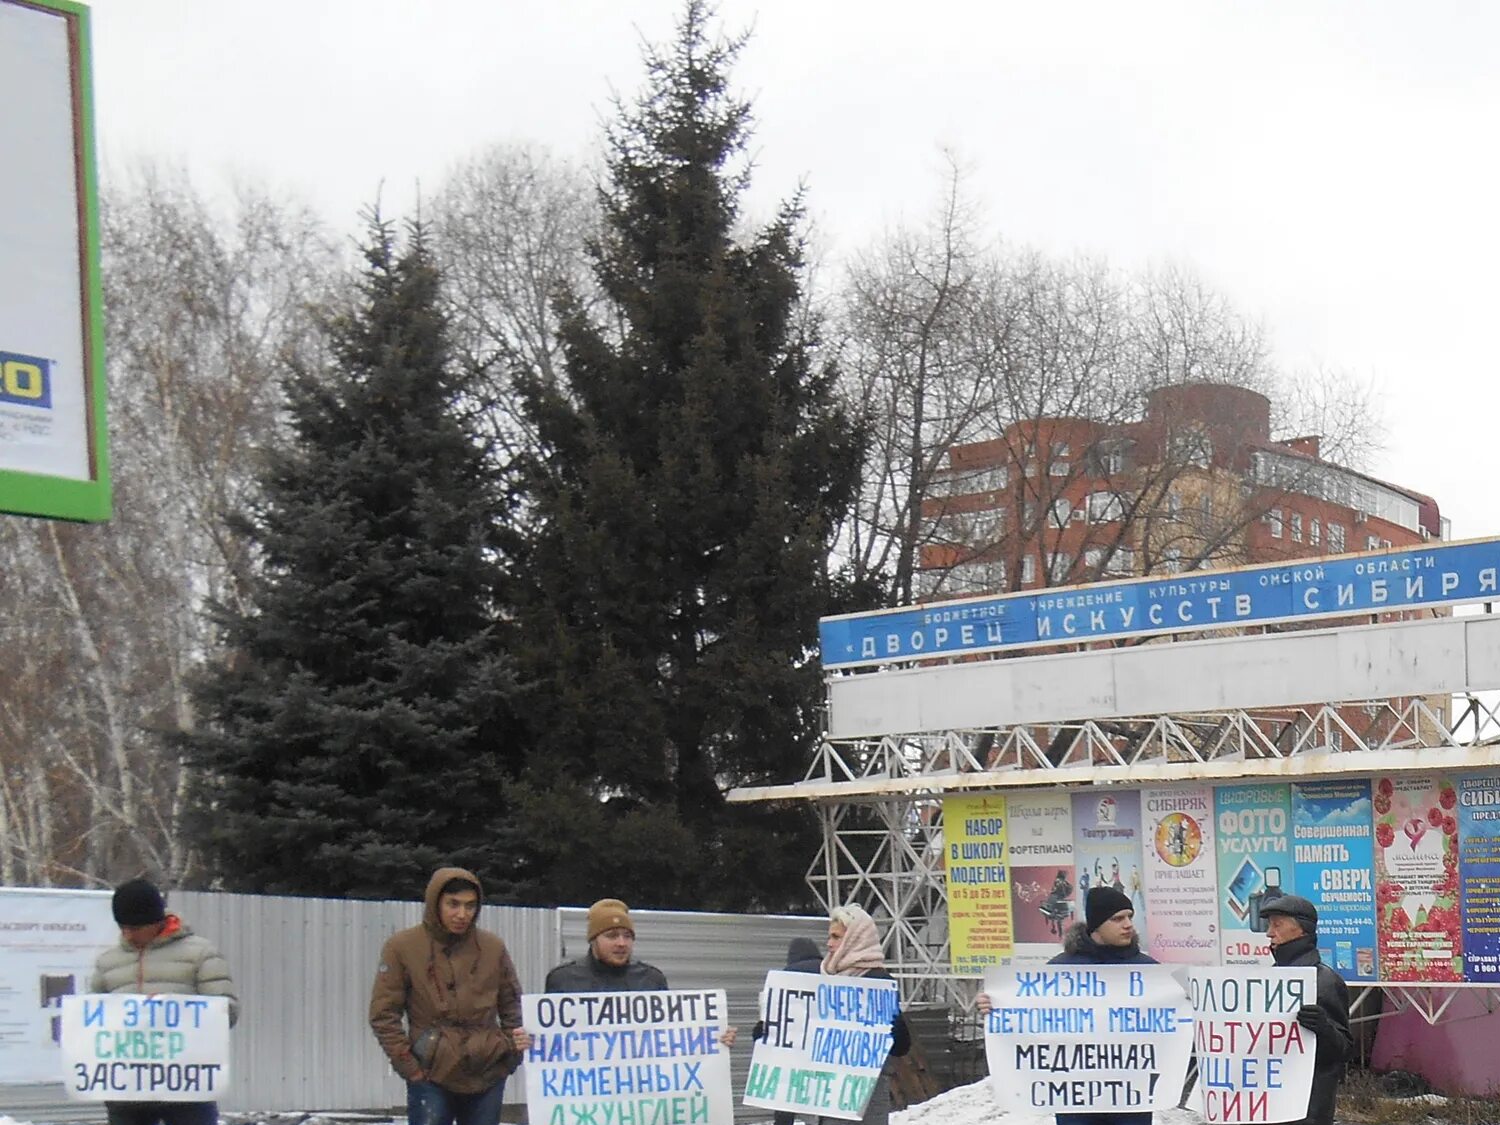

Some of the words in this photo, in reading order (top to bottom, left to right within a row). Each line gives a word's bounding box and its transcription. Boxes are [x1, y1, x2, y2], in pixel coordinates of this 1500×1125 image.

[924, 605, 1005, 624] БЮДЖЕТНОЕ
[1030, 591, 1123, 611] УЧРЕЖДЕНИЕ
[1149, 580, 1231, 598] КУЛЬТУРЫ
[1259, 565, 1325, 586] ОМСКОЙ
[1355, 556, 1436, 576] ОБЛАСТИ
[1037, 594, 1252, 637] ИСКУССТВ
[1147, 797, 1207, 812] СИБИРЯК
[965, 818, 1003, 836] НАБОР
[1082, 828, 1106, 840] Театр
[1109, 828, 1134, 840] танца
[1219, 808, 1286, 835] ФОТО
[1294, 825, 1369, 839] Совершенная
[952, 844, 959, 860] В
[962, 842, 1004, 859] ШКОЛУ
[1009, 844, 1073, 855] ФОРТЕПИАНО
[1220, 837, 1287, 852] УСЛУГИ
[1295, 844, 1349, 862] ПАМЯТЬ
[951, 862, 1006, 885] МОДЕЛЕЙ
[1154, 869, 1205, 879] ПРИГЛАШАЕТ
[1321, 869, 1371, 890] СВЕРХ
[1321, 892, 1371, 902] ОБУЧАЕМОСТЬ
[1236, 942, 1250, 956] 10
[1016, 971, 1106, 997] ЖИЗНЬ
[1129, 971, 1144, 997] В
[1189, 977, 1304, 1013] ОЛОГИЯ
[84, 1000, 105, 1027] И
[123, 999, 208, 1028] ЭТОТ
[537, 993, 718, 1028] ОСТАНОВИТЕ
[762, 987, 815, 1050] НЕТ
[817, 983, 899, 1027] ОЧЕРЕДНОЙ
[988, 1007, 1094, 1033] БЕТОННОМ
[95, 1031, 184, 1059] СКВЕР
[528, 1026, 720, 1062] НАСТУПЛЕНИЕ
[811, 1027, 895, 1069] ПАРКОВКЕ
[1016, 1043, 1156, 1072] МЕДЛЕННАЯ
[74, 1061, 221, 1092] ЗАСТРОЯТ
[541, 1062, 704, 1097] КАМЕННЫХ
[746, 1063, 782, 1100] НА
[1031, 1073, 1160, 1106] СМЕРТЬ!
[1202, 1089, 1269, 1122] СИИ
